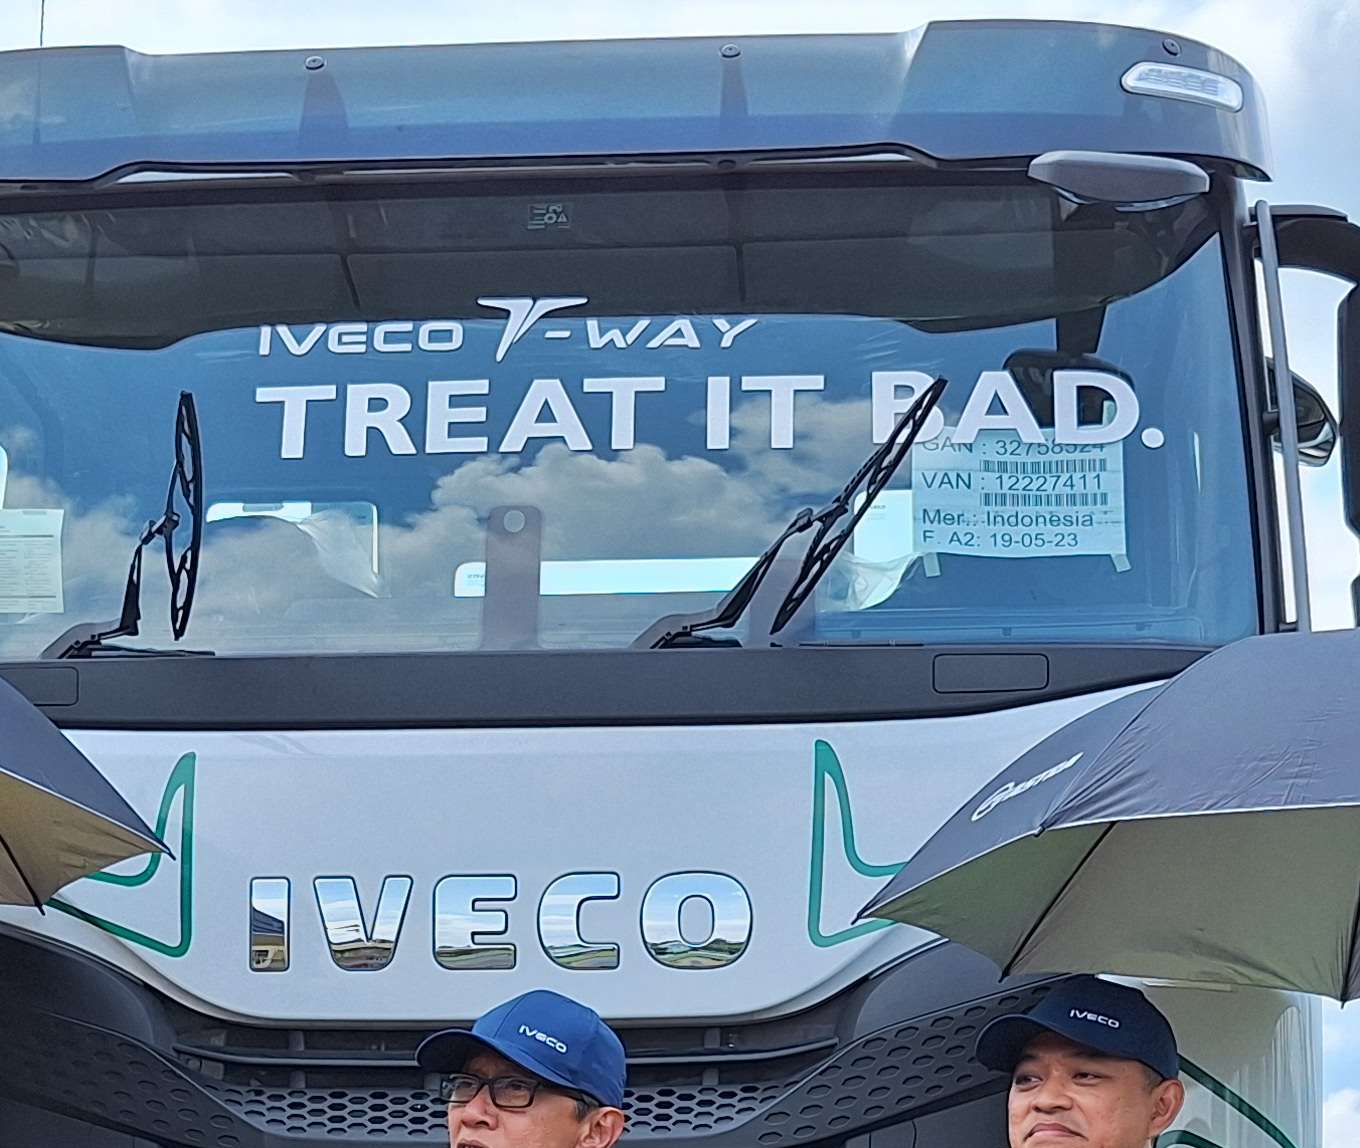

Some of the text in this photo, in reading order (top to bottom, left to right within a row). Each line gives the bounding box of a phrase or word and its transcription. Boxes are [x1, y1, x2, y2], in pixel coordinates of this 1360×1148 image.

[258, 320, 464, 356] IVECO
[256, 370, 1165, 458] TREAT IT BAD.
[921, 472, 972, 490] VAN
[995, 473, 1103, 492] 12227411
[986, 511, 1094, 527] Indonesia
[948, 531, 981, 547] A2:
[990, 532, 1079, 548] 19-05-23
[249, 872, 754, 972] IVECO
[1069, 1009, 1120, 1028] IVECO
[519, 1024, 568, 1054] IVECO
